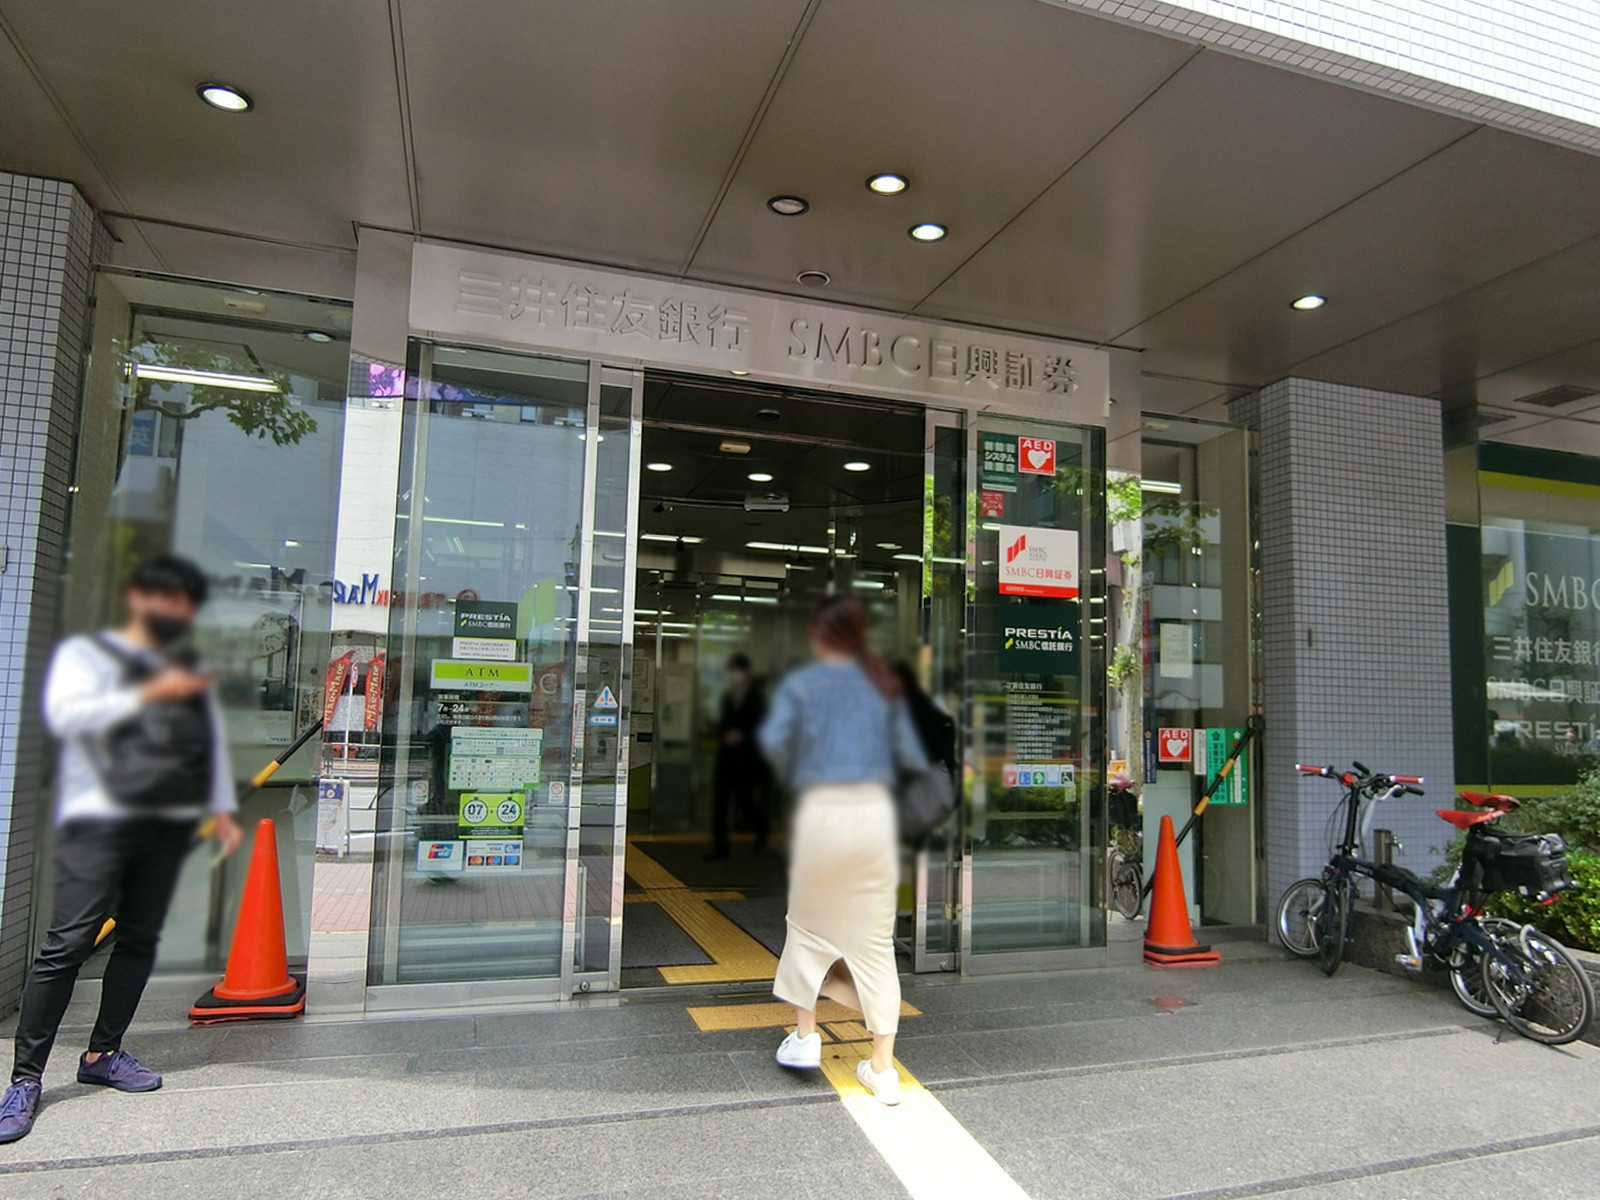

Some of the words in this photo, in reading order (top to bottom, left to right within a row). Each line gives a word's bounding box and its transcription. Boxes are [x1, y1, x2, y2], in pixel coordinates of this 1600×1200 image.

[456, 269, 749, 351] 三井住友銀行
[788, 317, 1080, 394] SMBC日興証券
[1023, 440, 1053, 451] AED
[466, 667, 499, 677] ATM
[1162, 730, 1188, 739] AED
[468, 804, 483, 815] 07
[502, 804, 516, 815] 24
